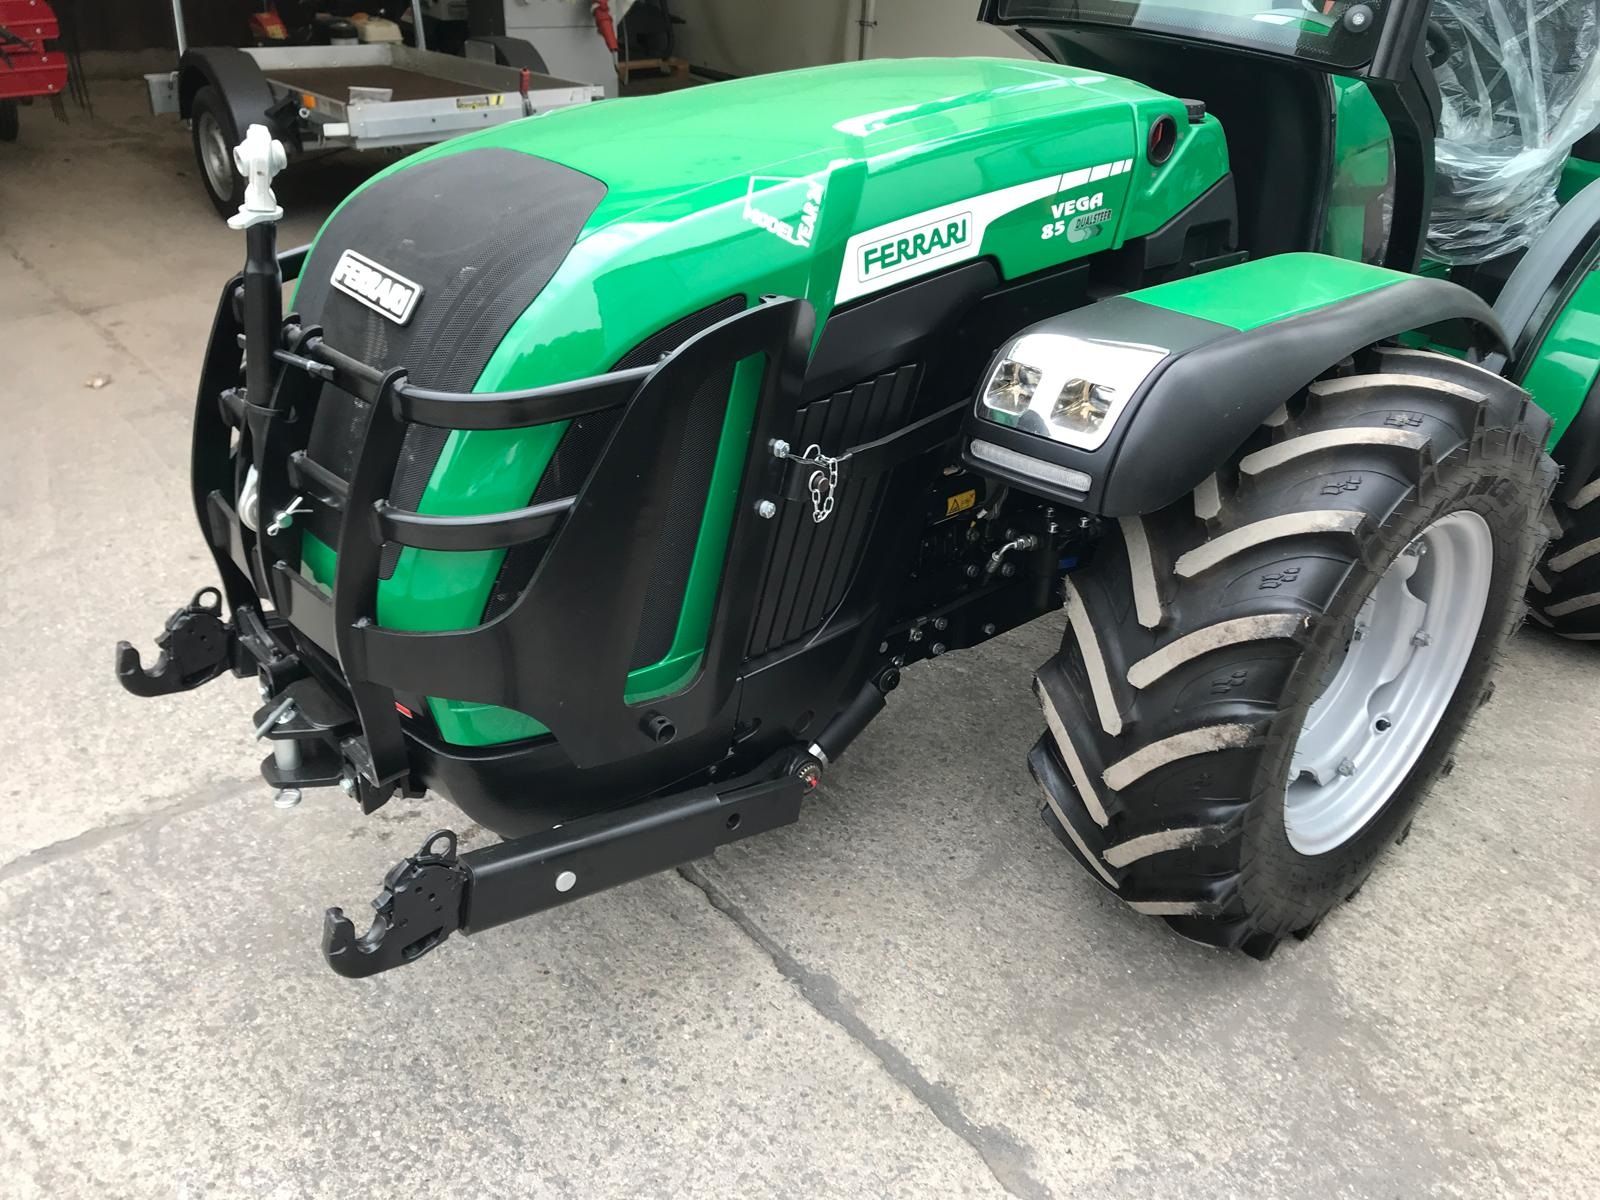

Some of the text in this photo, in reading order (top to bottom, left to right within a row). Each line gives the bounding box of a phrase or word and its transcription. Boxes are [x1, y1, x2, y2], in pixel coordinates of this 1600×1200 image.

[1051, 192, 1103, 219] VEGA
[1041, 220, 1065, 239] 85
[1075, 210, 1112, 229] DUALSTEER
[864, 219, 966, 274] FERRARI
